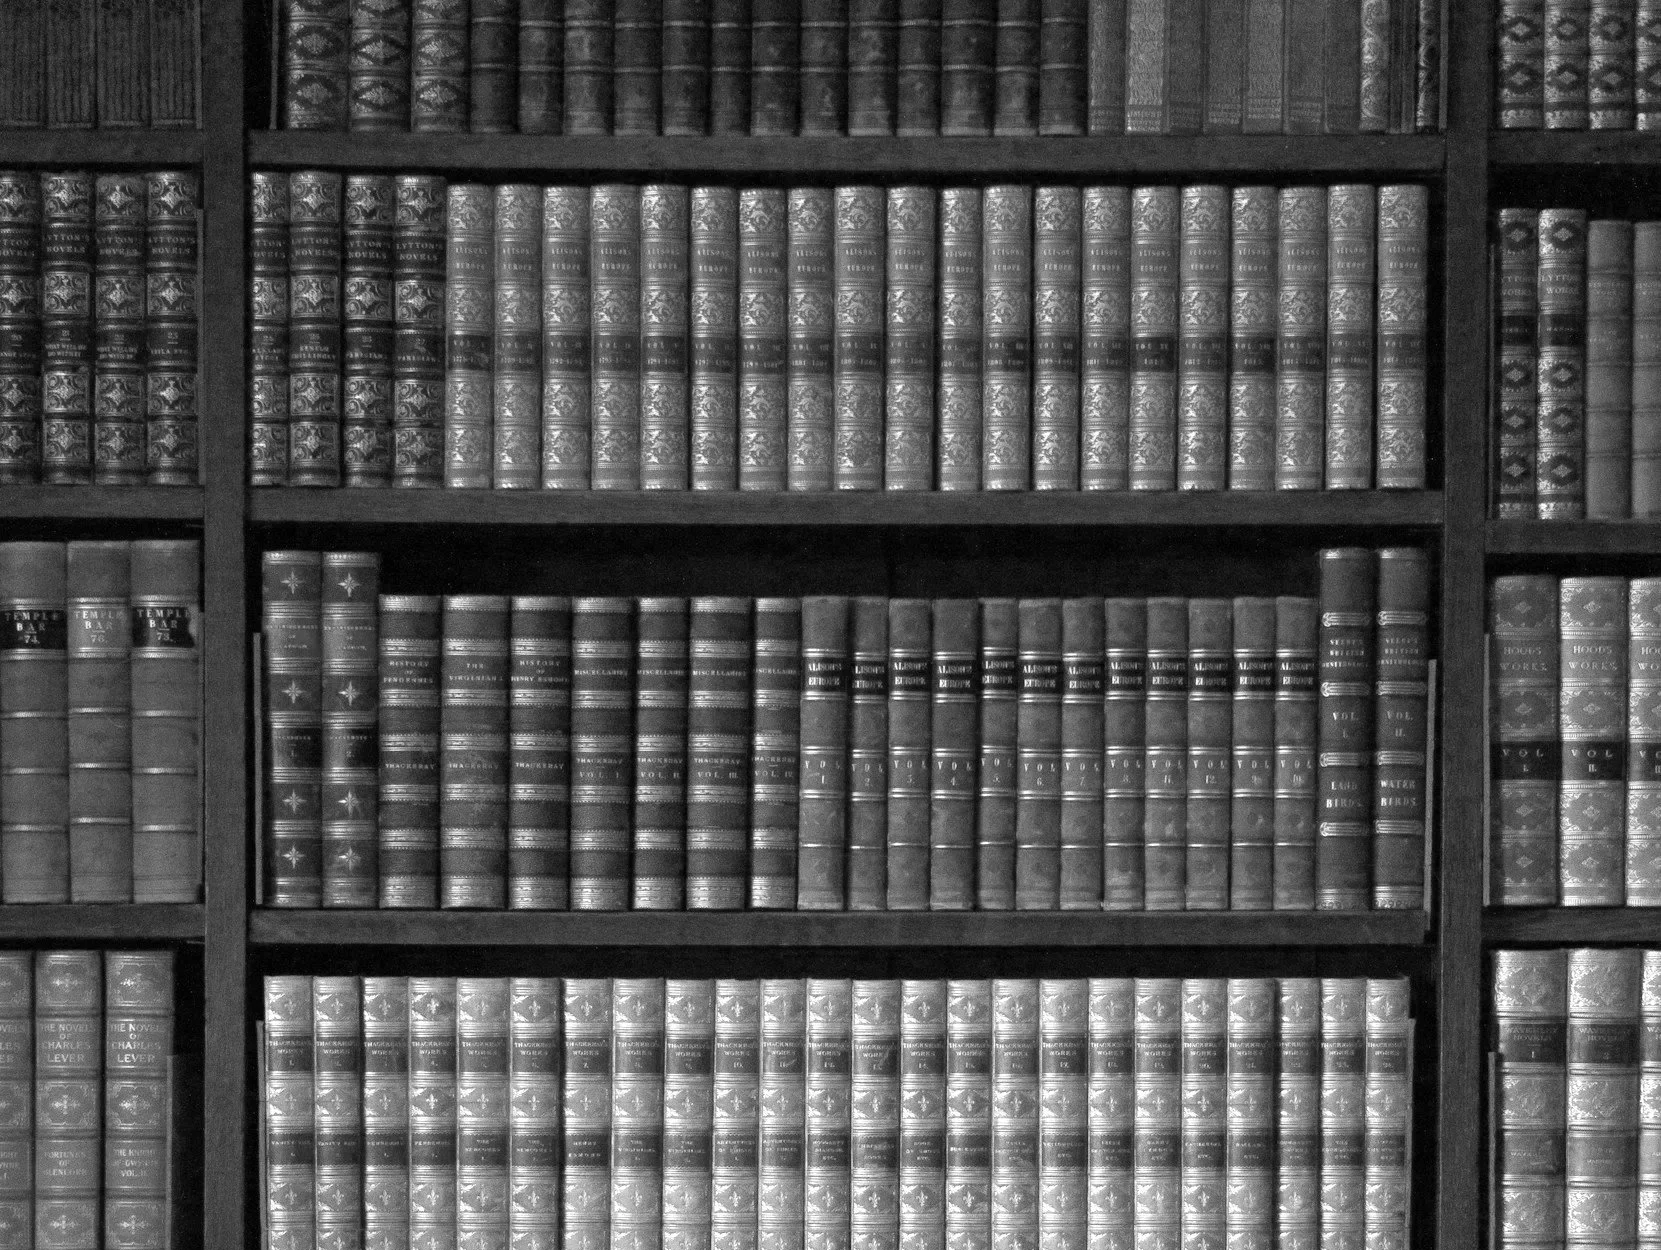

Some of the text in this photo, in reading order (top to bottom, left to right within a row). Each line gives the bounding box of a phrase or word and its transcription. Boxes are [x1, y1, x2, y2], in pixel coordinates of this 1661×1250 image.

[16, 622, 45, 632] BAR
[84, 620, 112, 631] BAR
[148, 619, 177, 629] BAR
[1380, 797, 1417, 807] BIRDS
[47, 1054, 85, 1063] LEVER
[116, 1054, 156, 1063] LEVER
